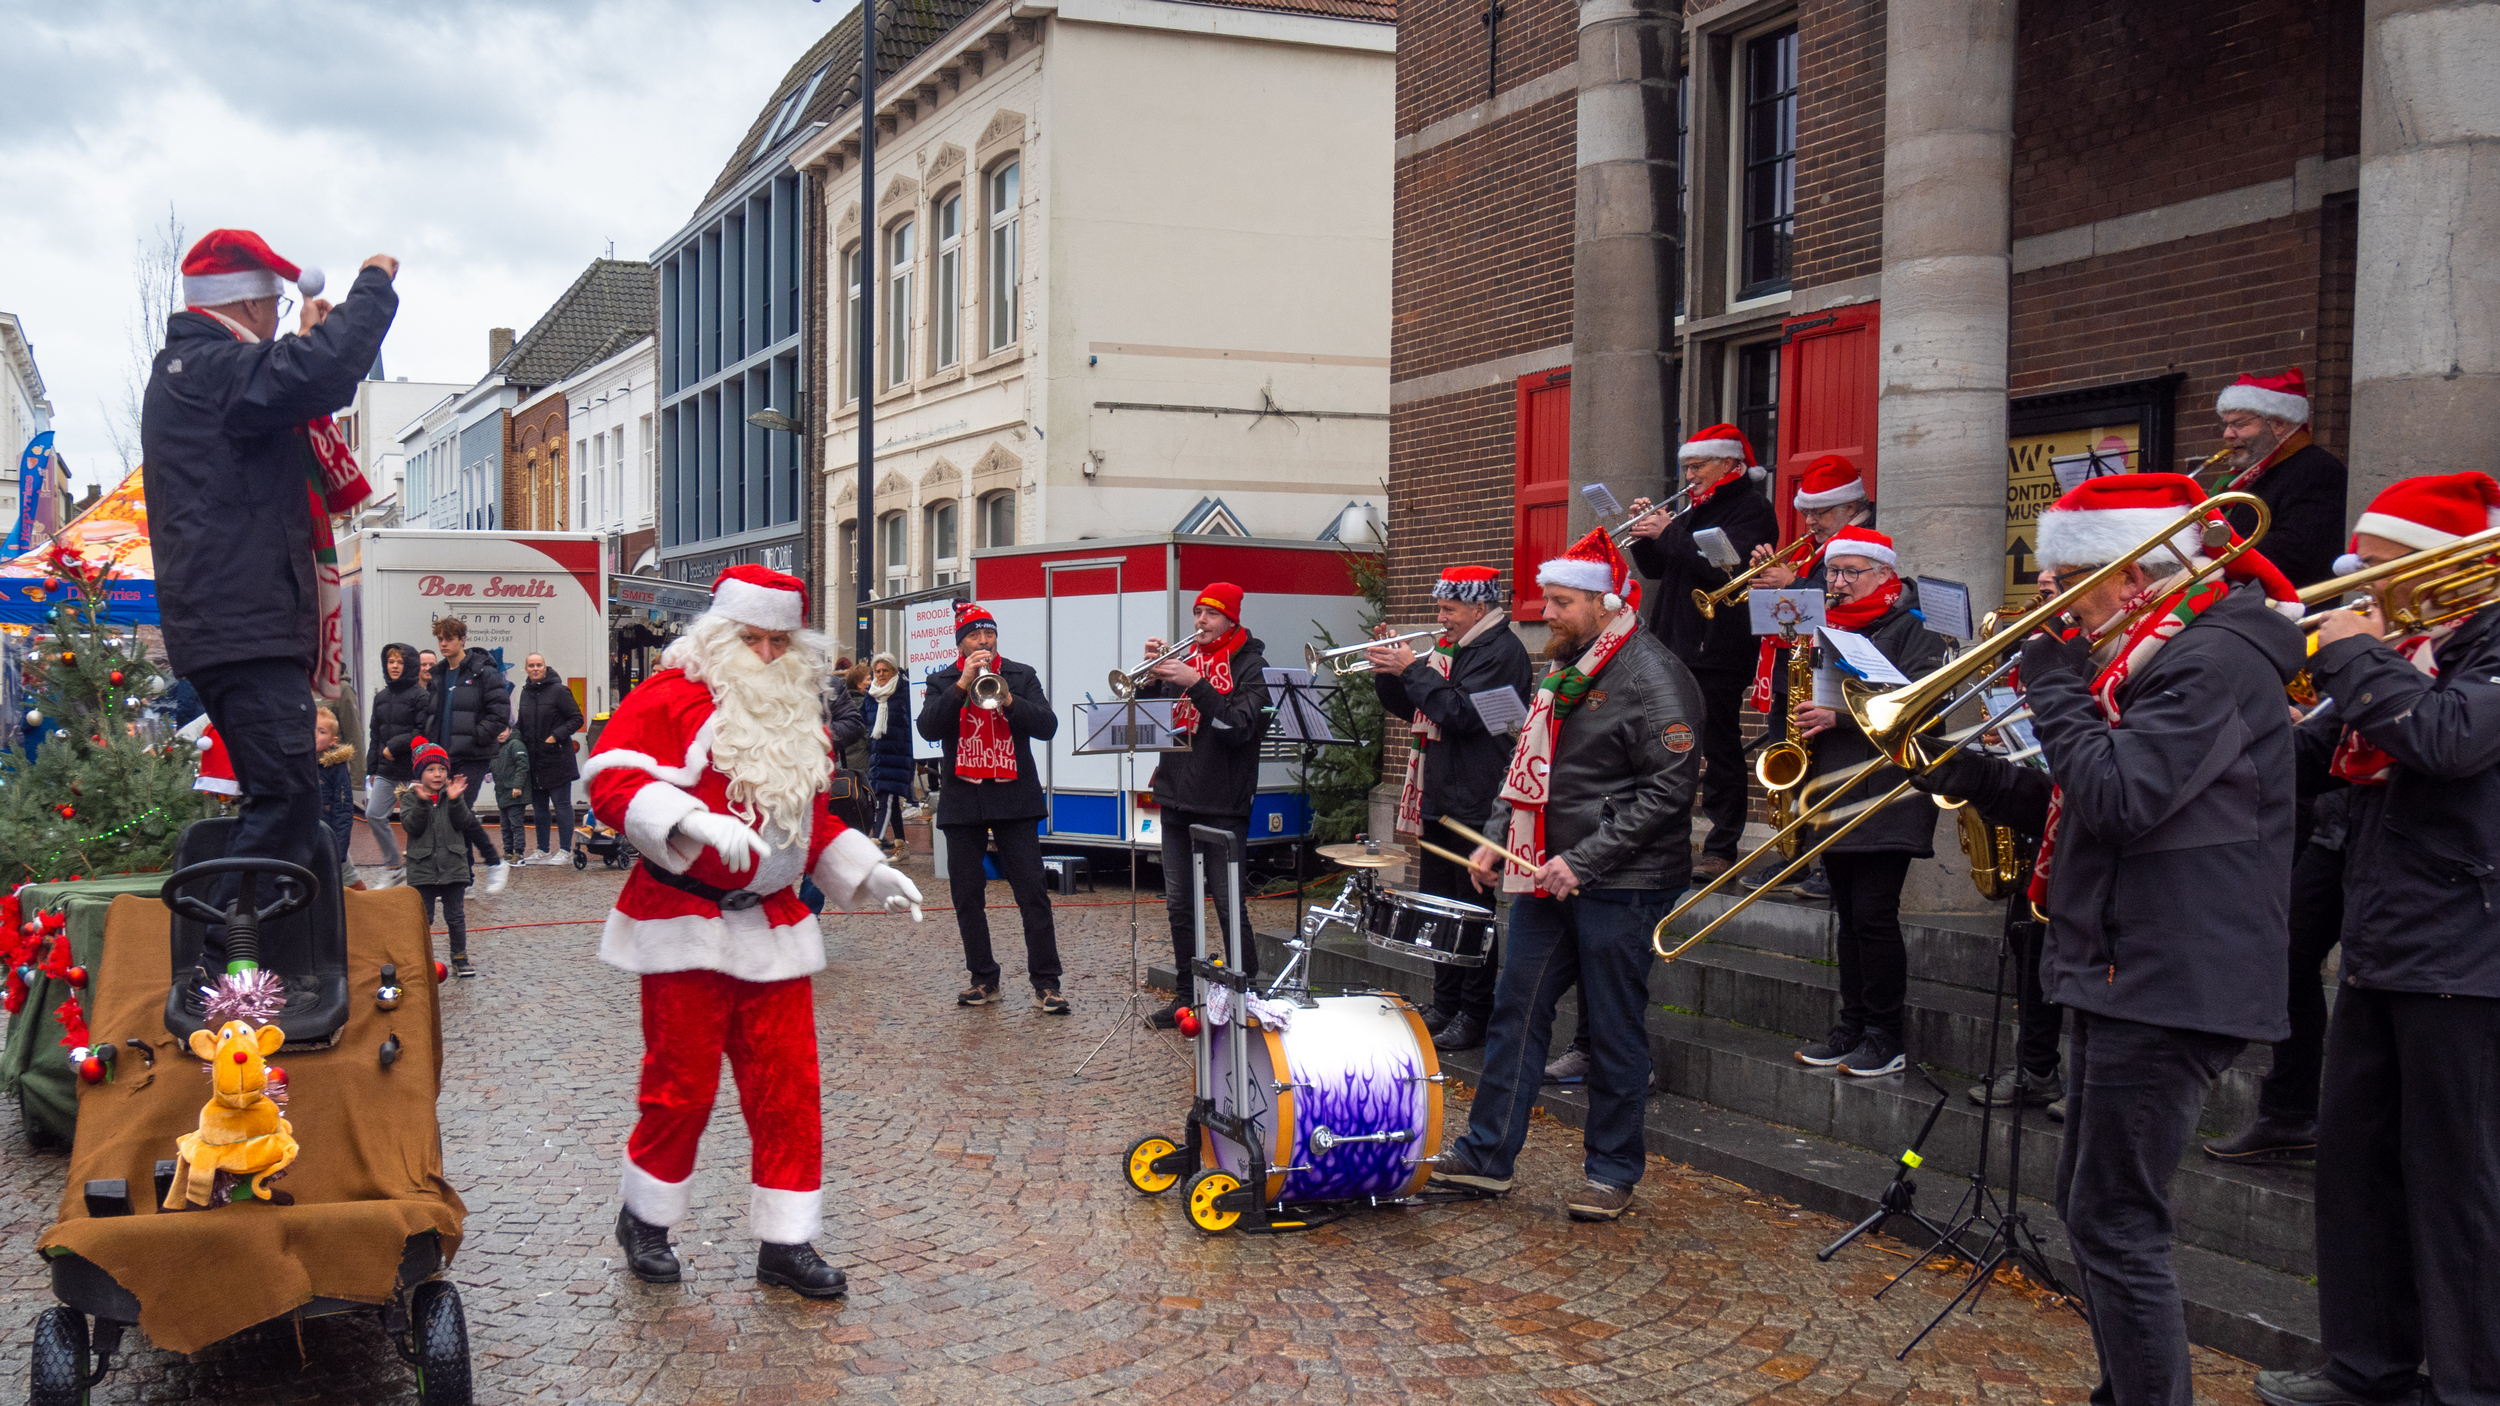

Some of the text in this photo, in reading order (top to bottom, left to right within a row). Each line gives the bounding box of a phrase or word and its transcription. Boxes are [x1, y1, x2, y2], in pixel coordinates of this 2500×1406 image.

[2007, 483, 2062, 503] ONTDE
[418, 575, 557, 598] Ben Smits
[621, 589, 704, 610] SMITS BEENMODE
[917, 608, 950, 621] BROODJE
[930, 638, 940, 649] OF
